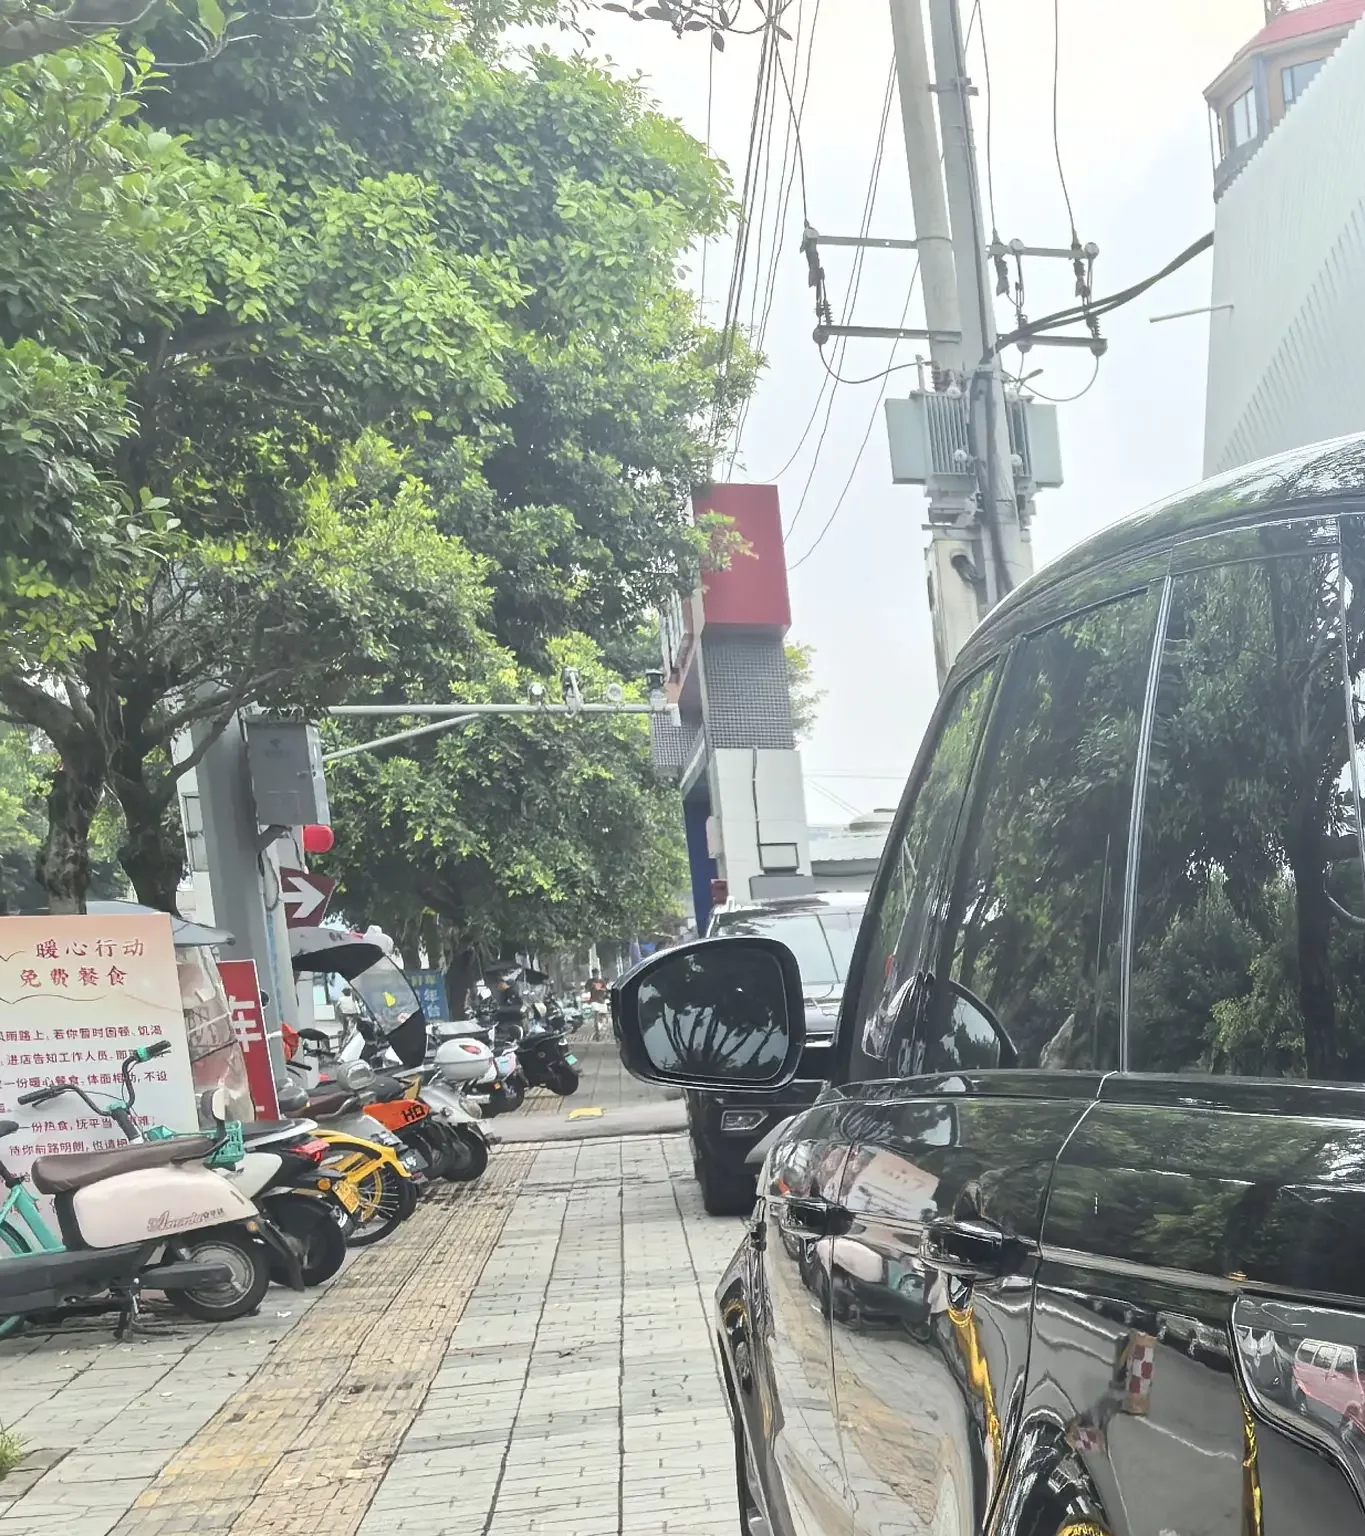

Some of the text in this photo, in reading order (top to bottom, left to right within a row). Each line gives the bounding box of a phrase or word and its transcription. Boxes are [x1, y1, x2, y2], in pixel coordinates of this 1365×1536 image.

[36, 939, 144, 959] 暖心行动
[20, 965, 128, 988] 免费餐食
